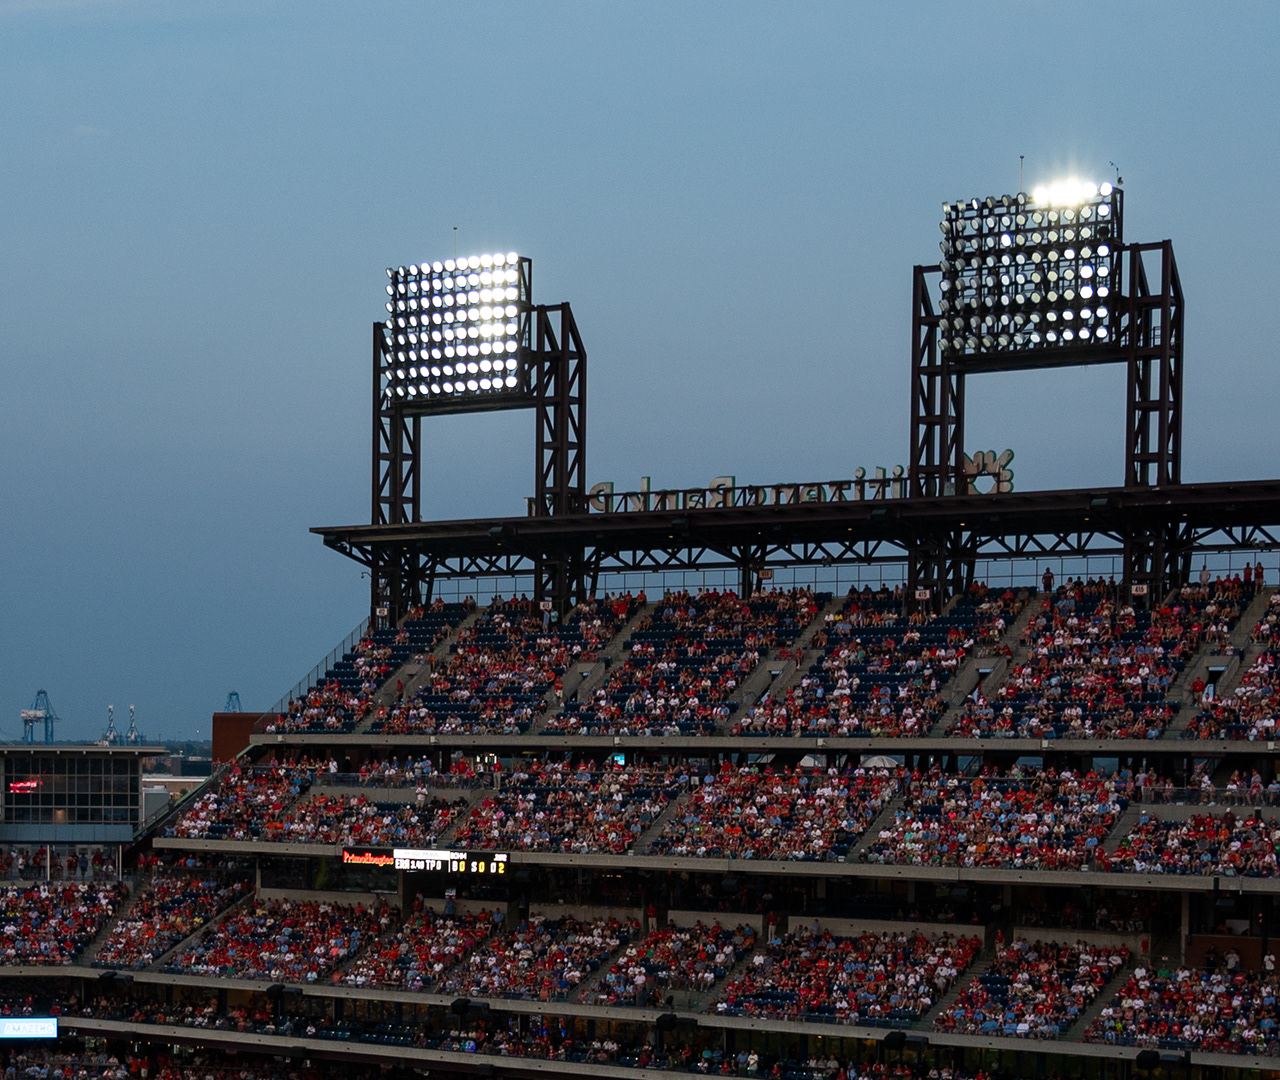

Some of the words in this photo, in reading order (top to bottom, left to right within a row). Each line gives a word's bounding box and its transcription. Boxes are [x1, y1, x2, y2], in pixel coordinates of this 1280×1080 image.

[343, 850, 394, 867] PrimoHoagies
[459, 861, 466, 872] 0
[470, 861, 478, 872] S
[478, 861, 485, 872] 0
[498, 862, 505, 874] 2
[4, 1022, 54, 1035] AMAZING
